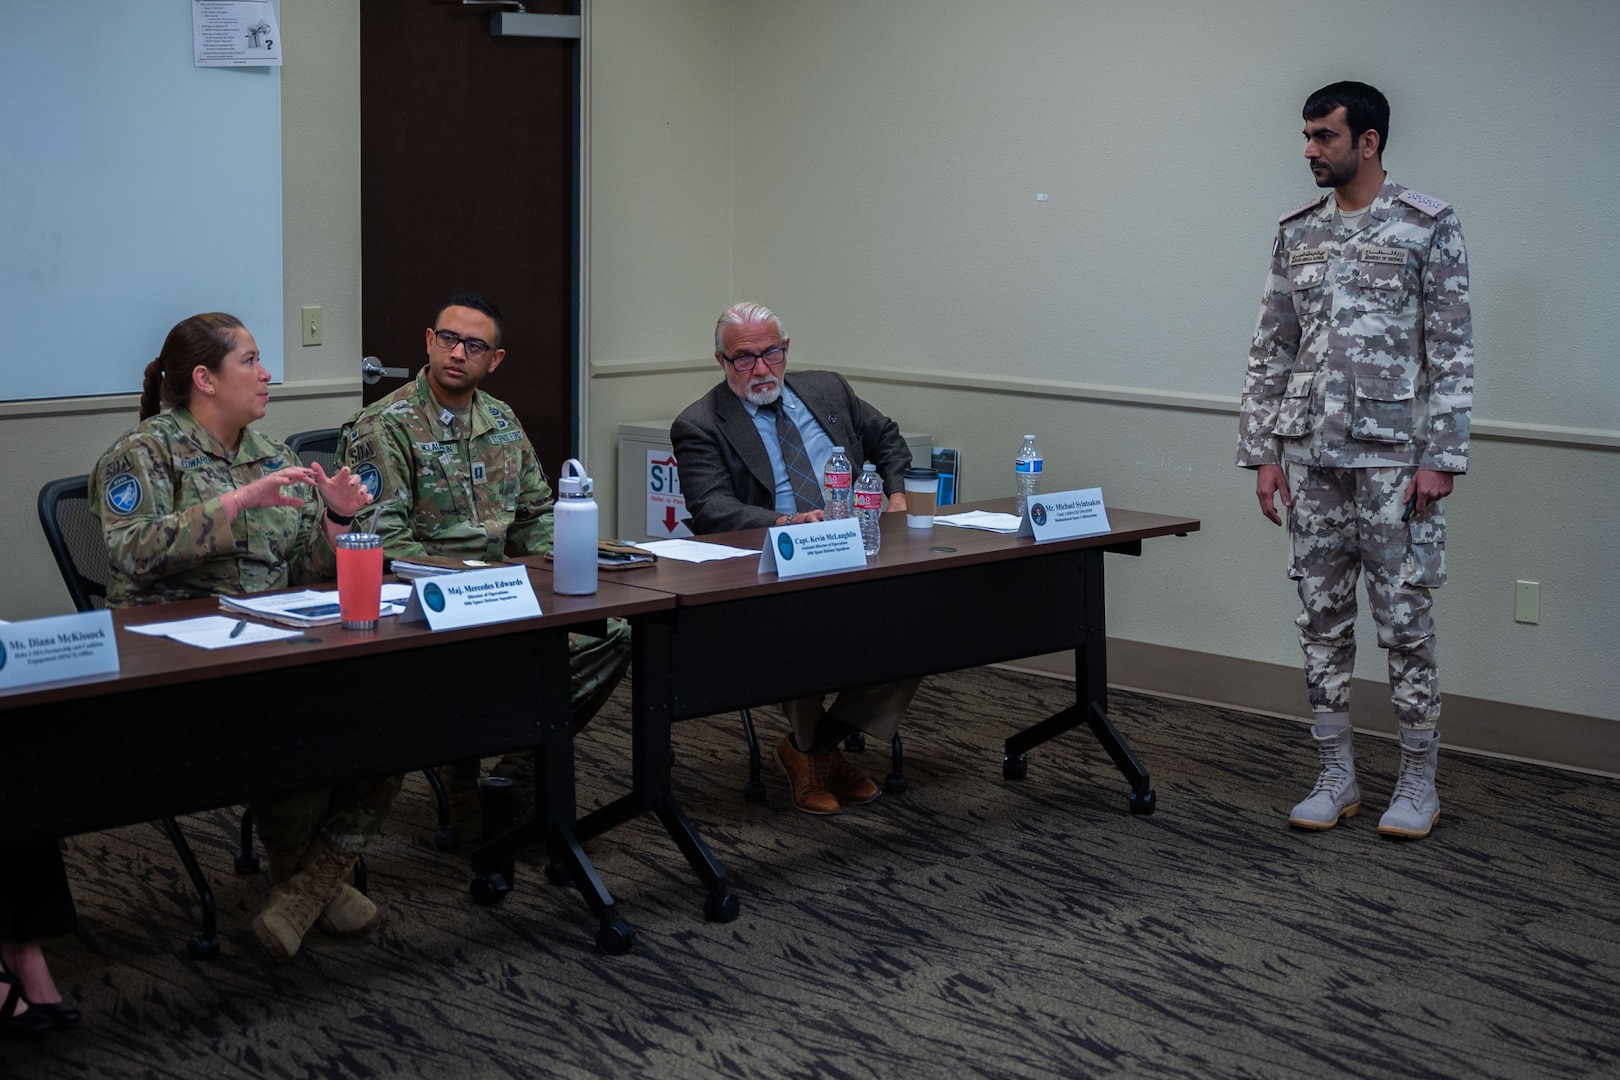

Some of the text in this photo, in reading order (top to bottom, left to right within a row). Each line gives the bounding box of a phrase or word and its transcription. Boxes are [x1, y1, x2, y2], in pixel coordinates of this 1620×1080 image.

[1056, 502, 1075, 510] Michael
[795, 537, 809, 545] Capt.
[826, 531, 856, 540] McLaughlin
[448, 579, 523, 596] Maj. Mercedes Edwards
[9, 628, 106, 651] Ms. Diana McKissock
